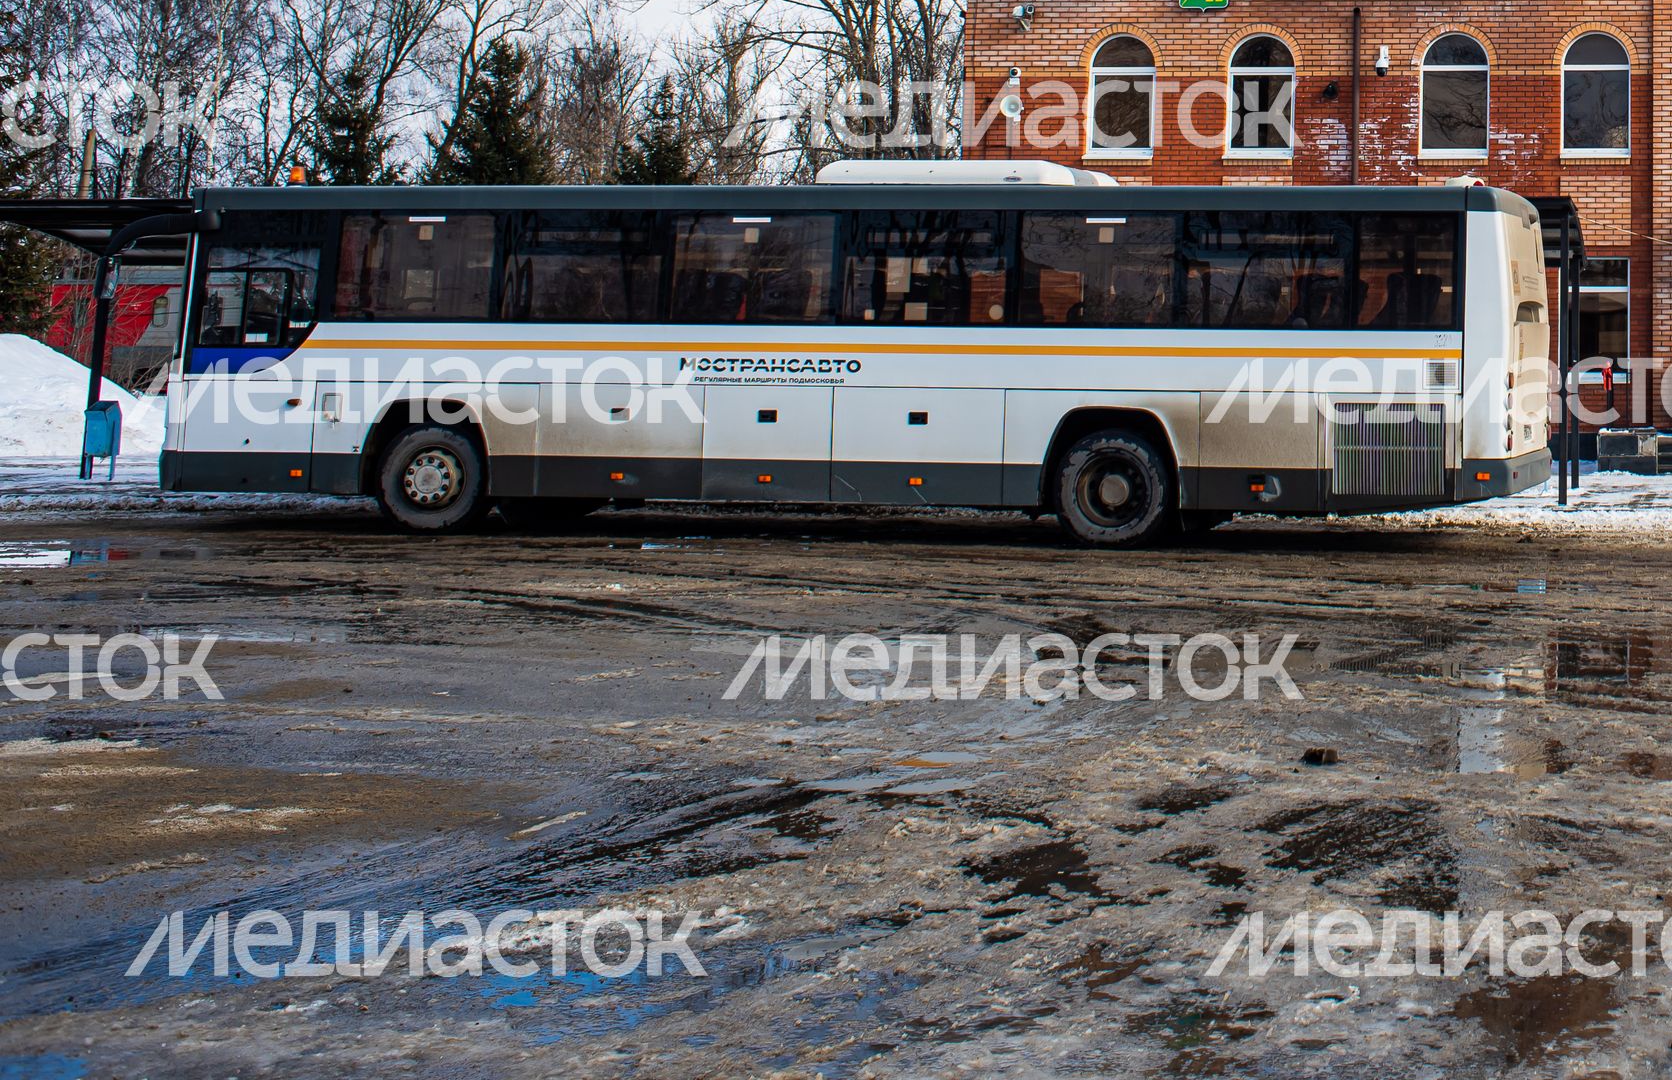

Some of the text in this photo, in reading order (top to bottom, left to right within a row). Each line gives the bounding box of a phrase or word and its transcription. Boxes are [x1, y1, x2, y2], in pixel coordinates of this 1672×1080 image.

[679, 357, 862, 374] МОСТРАНСАВТО
[694, 376, 743, 384] РЕГУЛЯРНЫЕ
[789, 377, 845, 385] ПОДМОСКОВЬЯ
